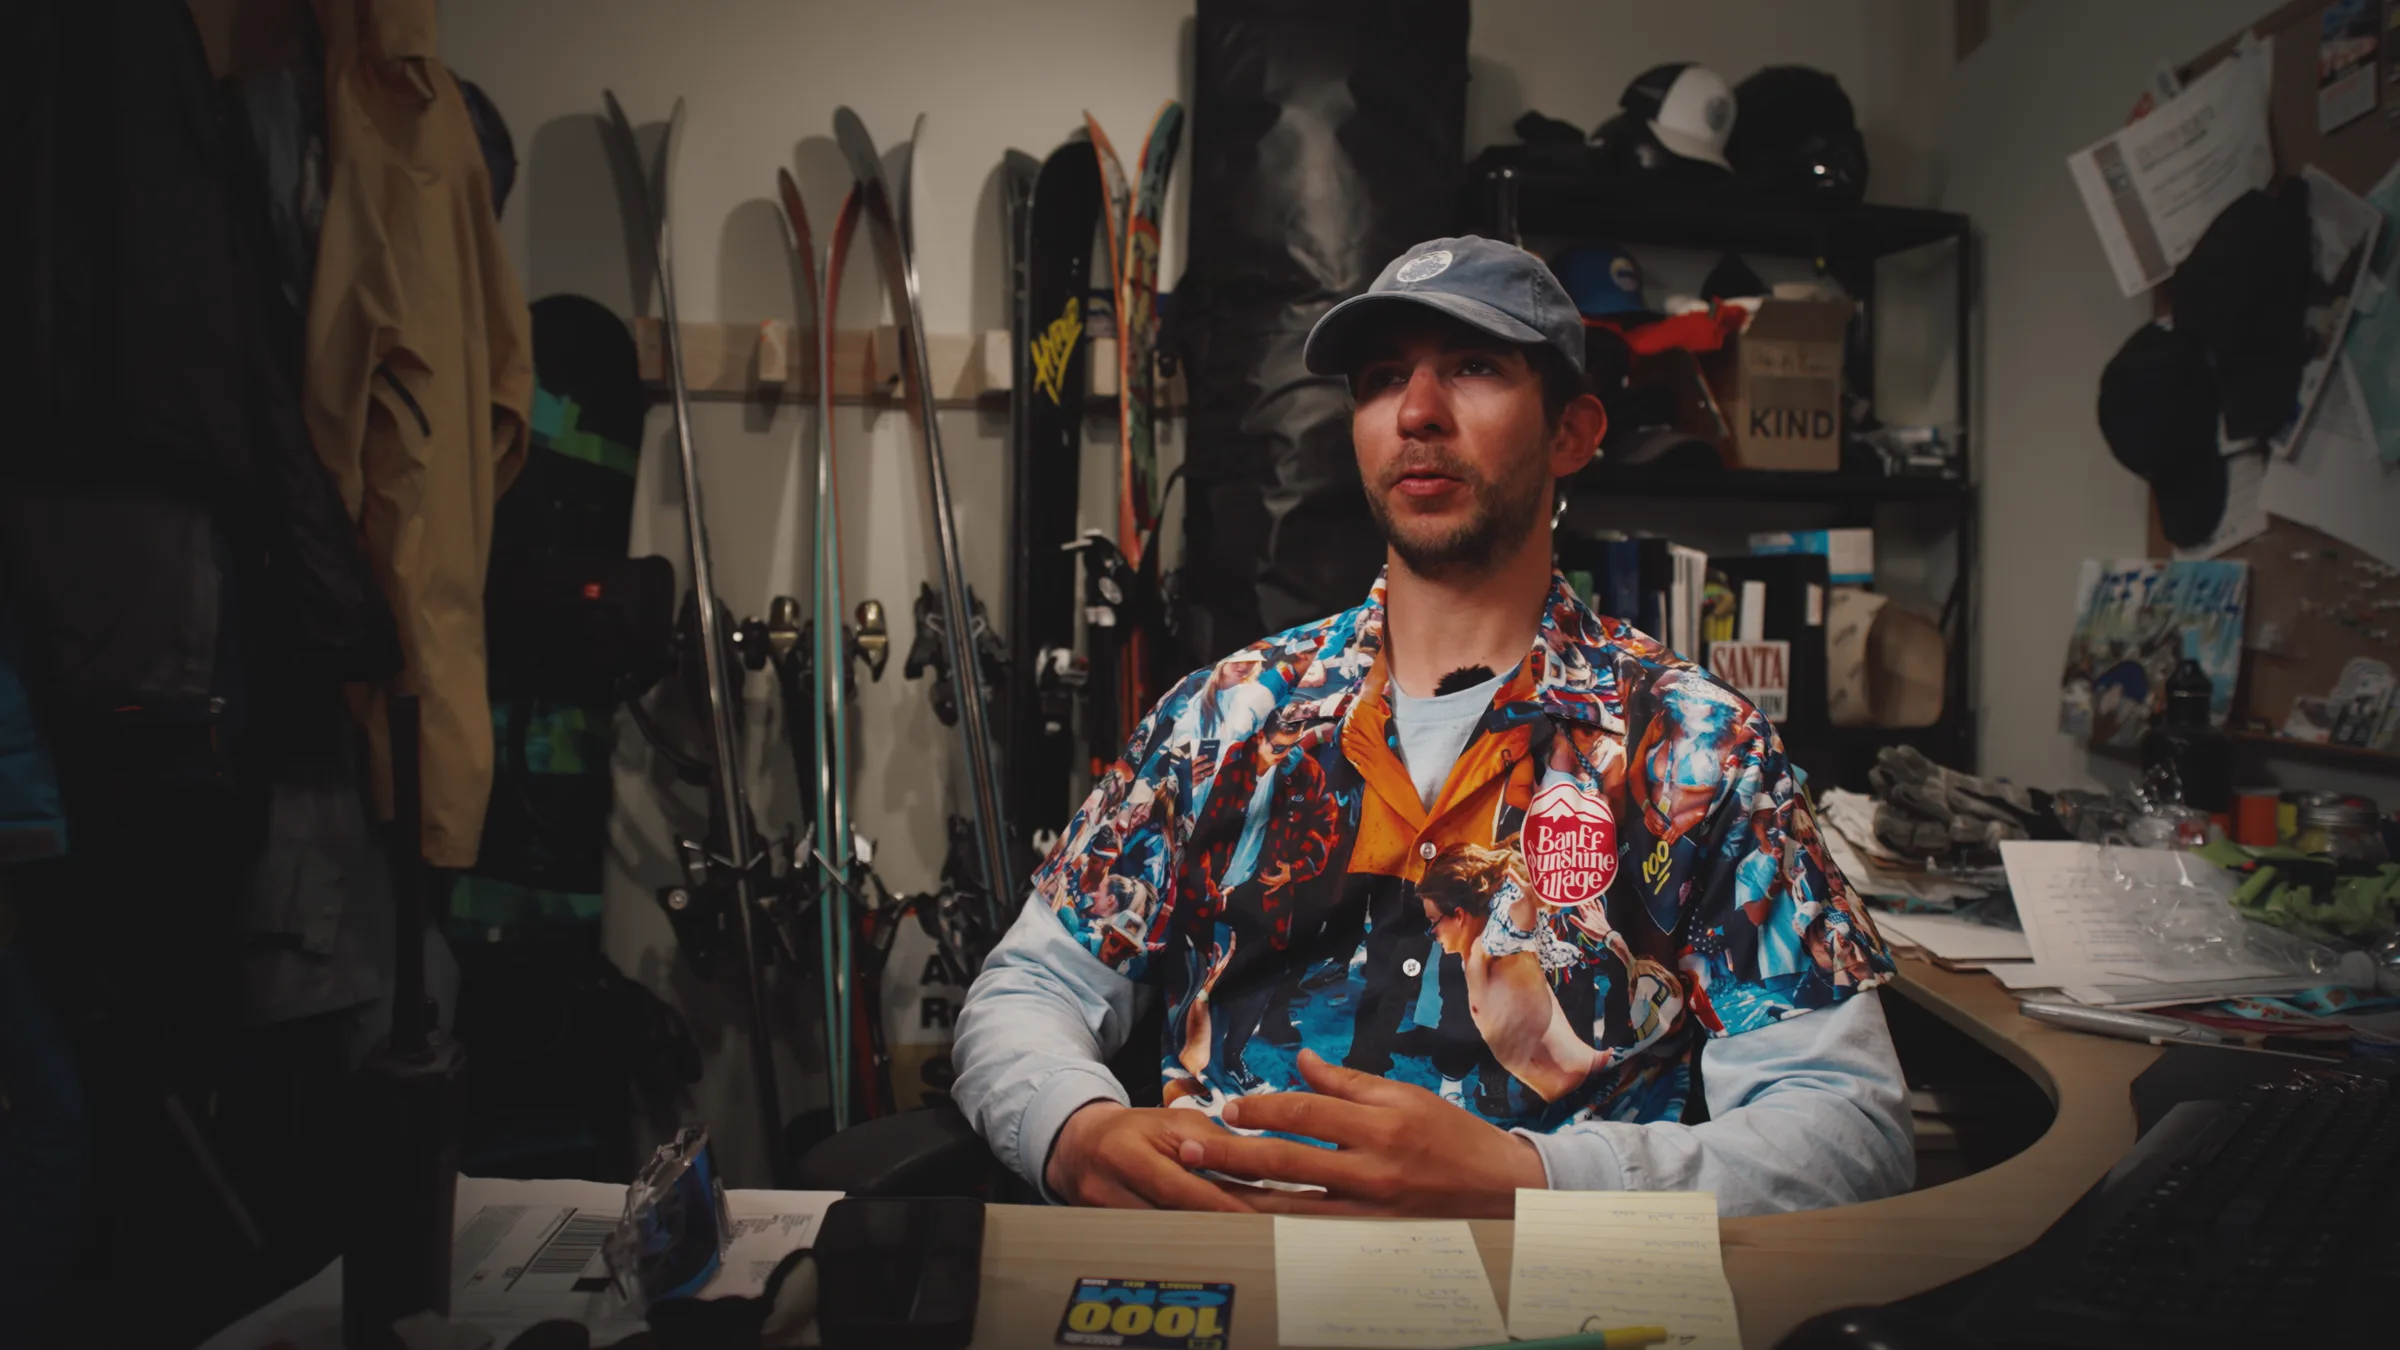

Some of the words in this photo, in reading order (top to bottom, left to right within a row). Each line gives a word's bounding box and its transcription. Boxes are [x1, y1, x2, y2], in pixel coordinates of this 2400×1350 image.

[1749, 407, 1835, 440] KIND
[1712, 645, 1785, 689] SANTA
[1536, 824, 1604, 853] Banff
[1527, 840, 1615, 874] Sunshine
[1642, 840, 1669, 884] 100
[1532, 869, 1603, 900] Village
[1076, 1286, 1228, 1307] CM
[1068, 1302, 1223, 1338] 1000
